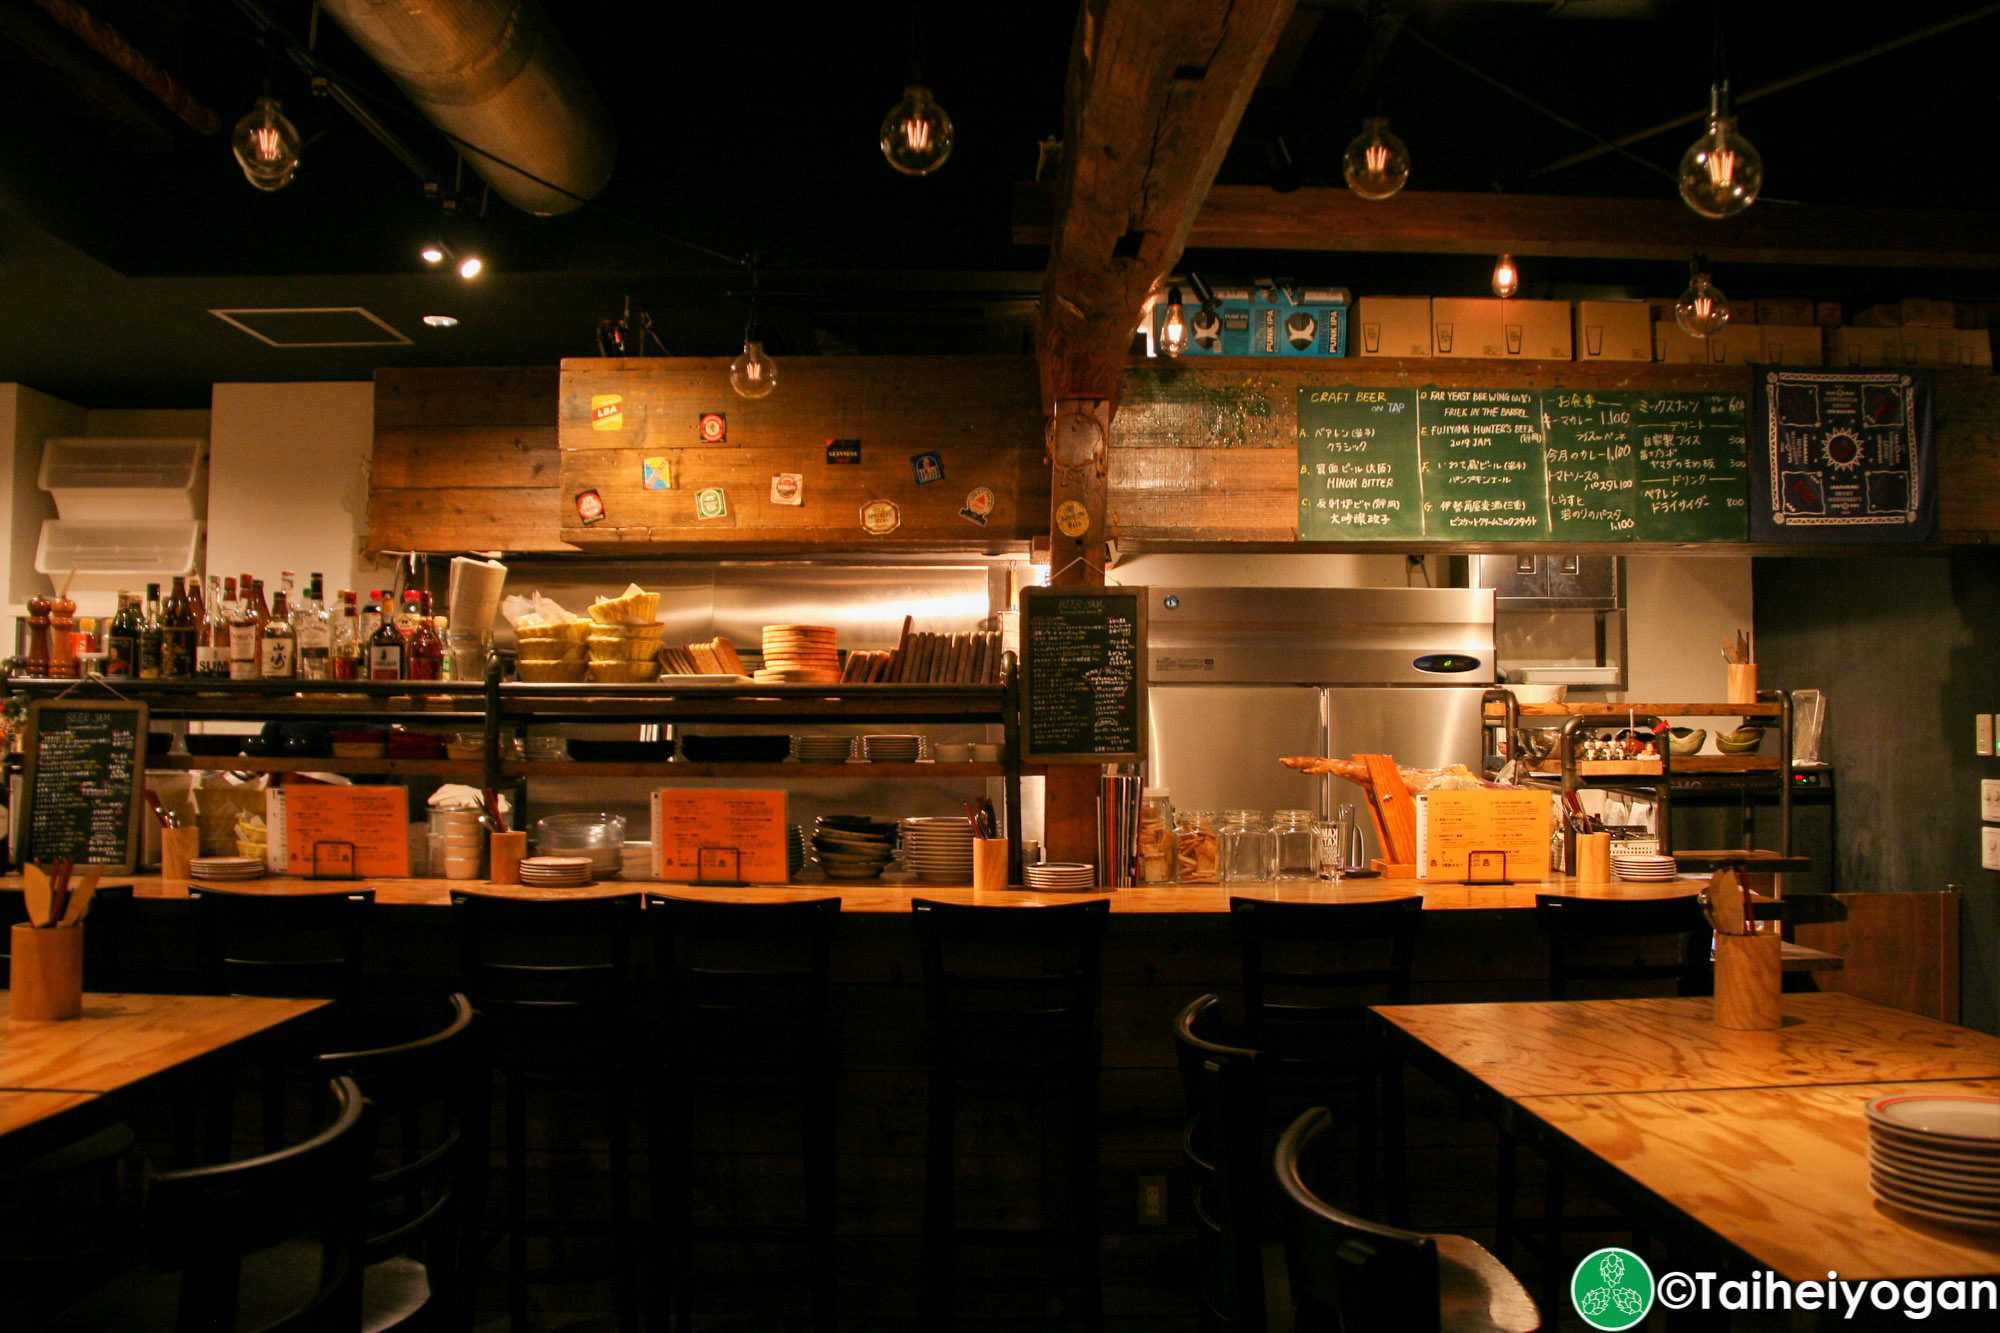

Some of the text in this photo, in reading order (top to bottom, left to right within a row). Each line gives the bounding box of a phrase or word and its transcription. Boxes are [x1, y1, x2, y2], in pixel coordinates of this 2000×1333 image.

[1266, 310, 1275, 352] PUNK IPA
[1329, 310, 1338, 353] PUNK IPA
[1311, 392, 1387, 402] CRAFT BEER
[1430, 390, 1446, 401] FAR
[1448, 391, 1471, 401] YEAST
[1387, 402, 1404, 413] TAP
[1470, 407, 1479, 417] IN
[1482, 407, 1500, 417] THE
[1431, 425, 1470, 436] FUJIYAMA
[1474, 424, 1512, 434] HUNTER'S
[1514, 424, 1534, 434] BEER
[1472, 438, 1492, 447] JAM
[1326, 478, 1394, 489] MINOH BITTER
